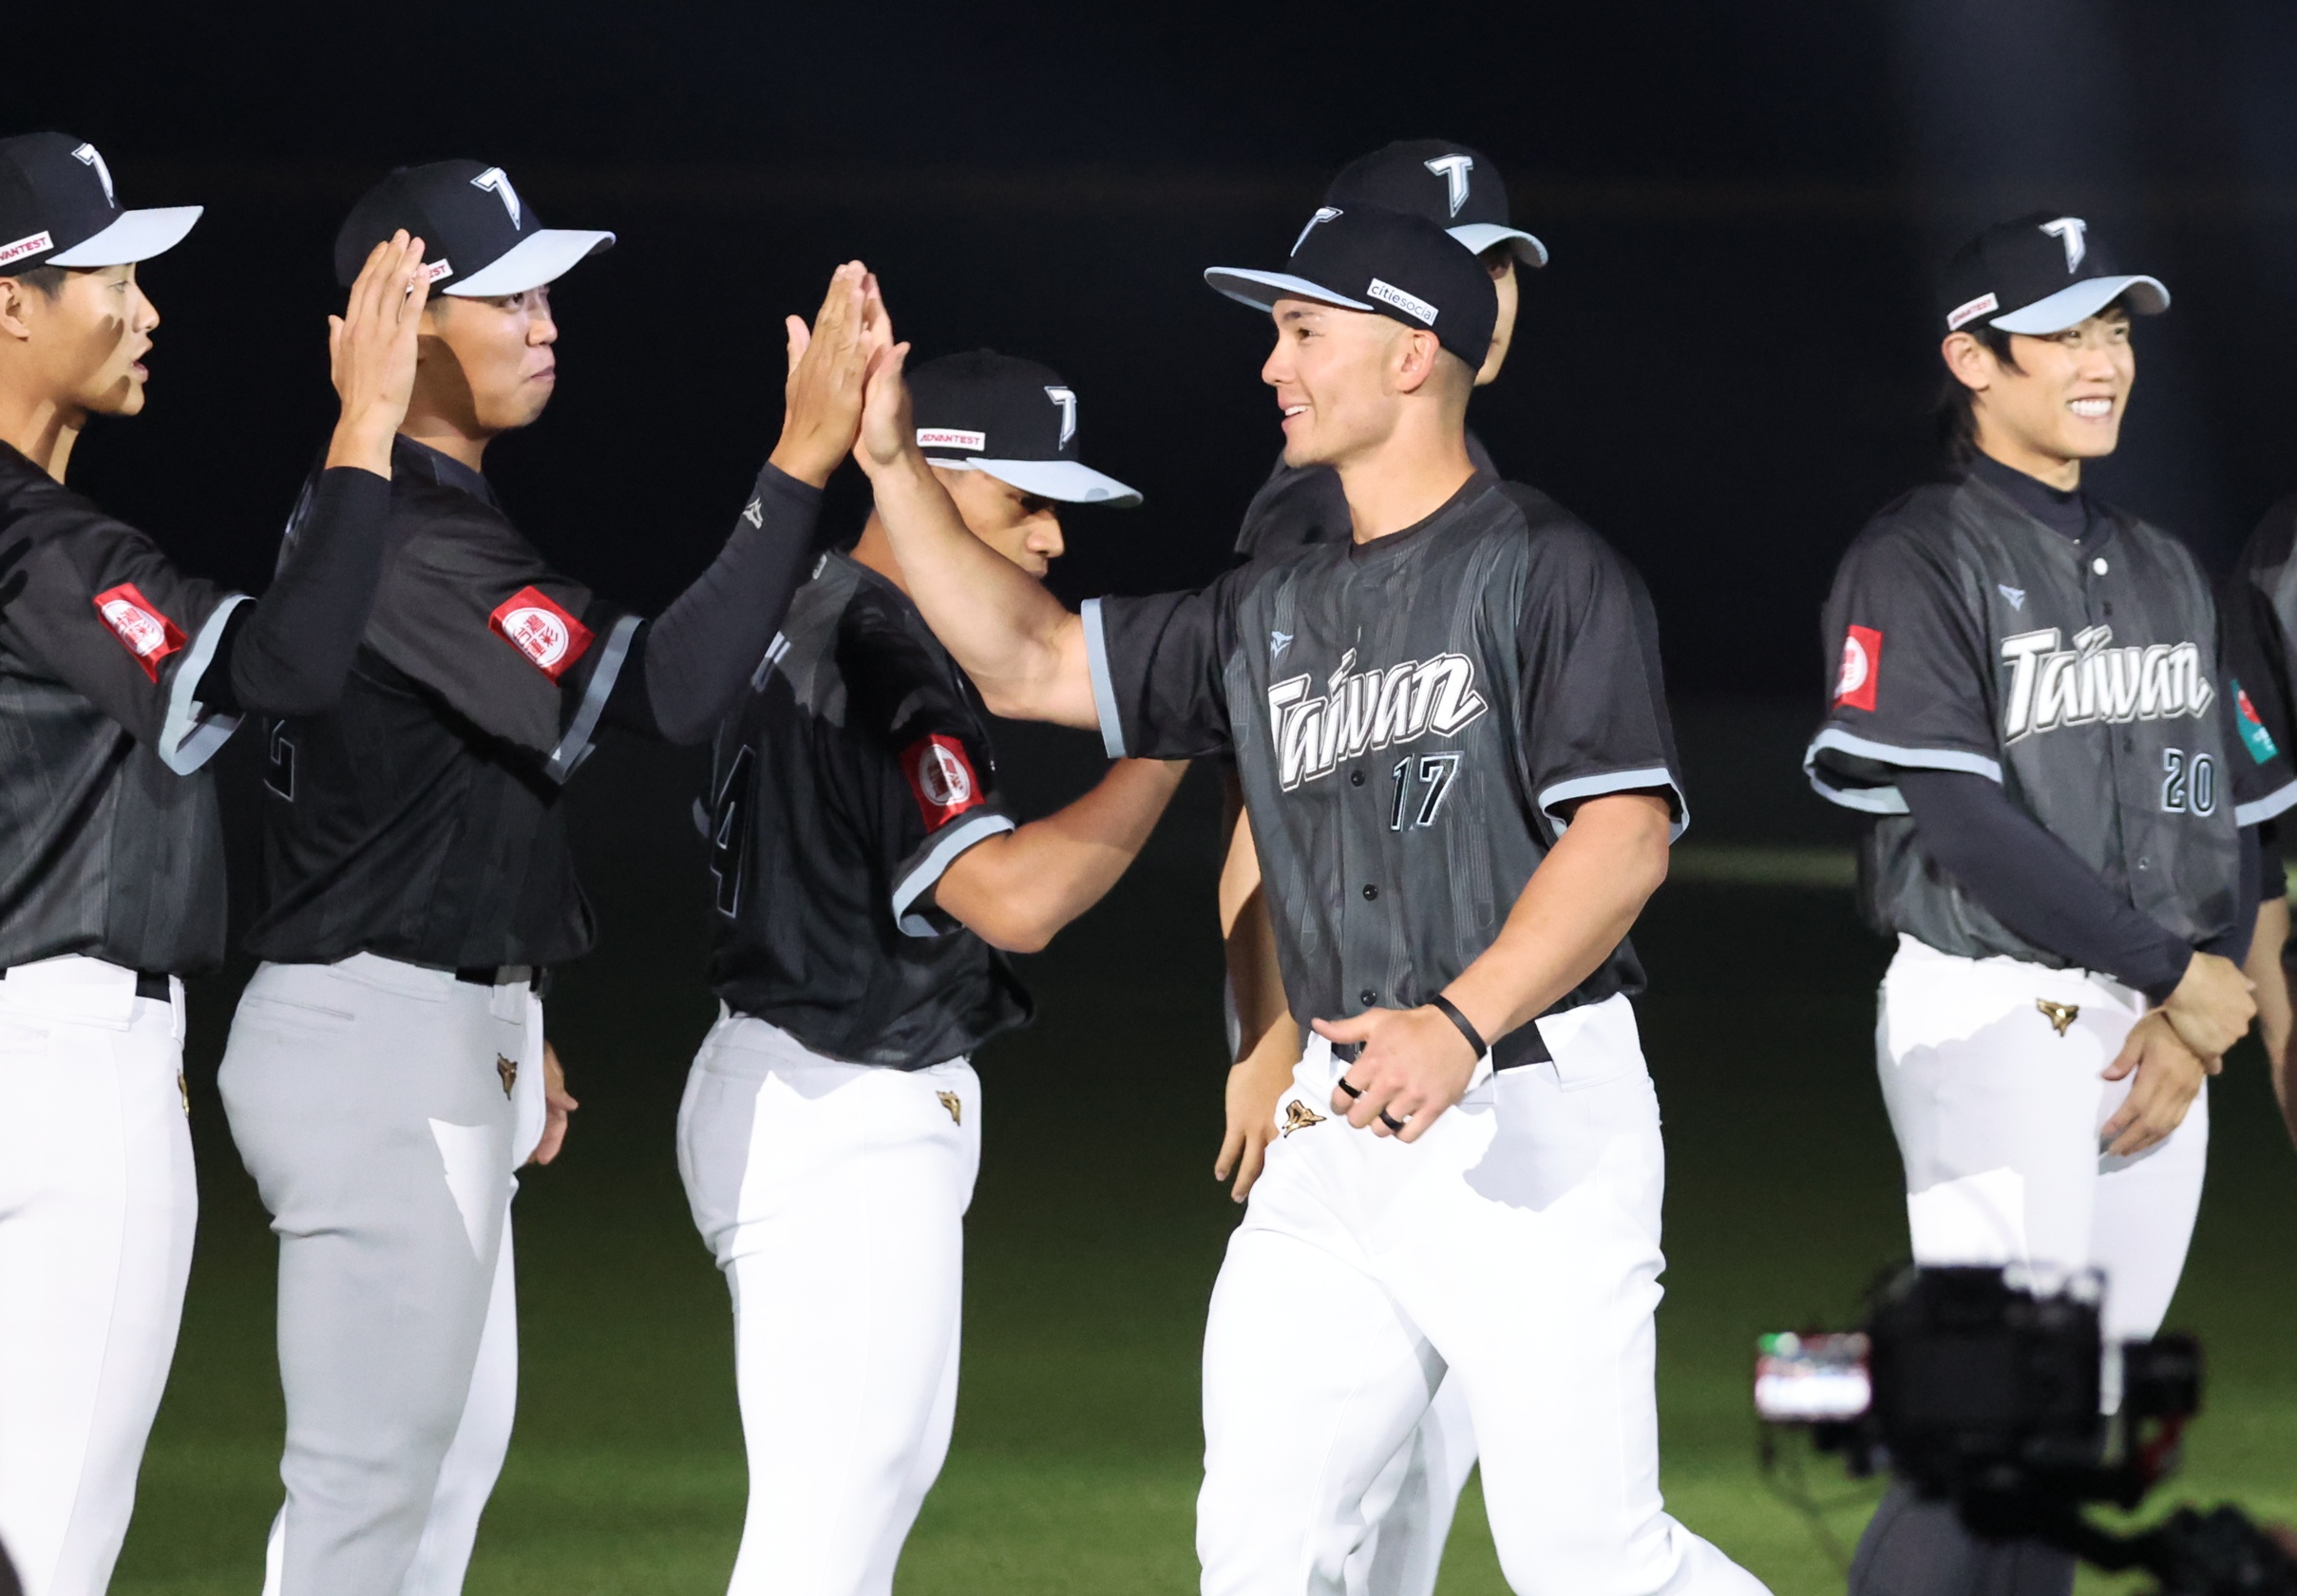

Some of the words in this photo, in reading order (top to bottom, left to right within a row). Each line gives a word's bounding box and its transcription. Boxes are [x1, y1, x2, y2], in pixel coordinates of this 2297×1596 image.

[1424, 153, 1473, 218] T
[2039, 216, 2088, 275] T
[1371, 284, 1436, 323] citiesocial
[920, 433, 981, 446] ADVANTEST
[2000, 623, 2216, 747] Taiwan
[1268, 647, 1489, 792] Taiwan
[1390, 750, 1464, 832] 17
[2161, 747, 2215, 817] 20
